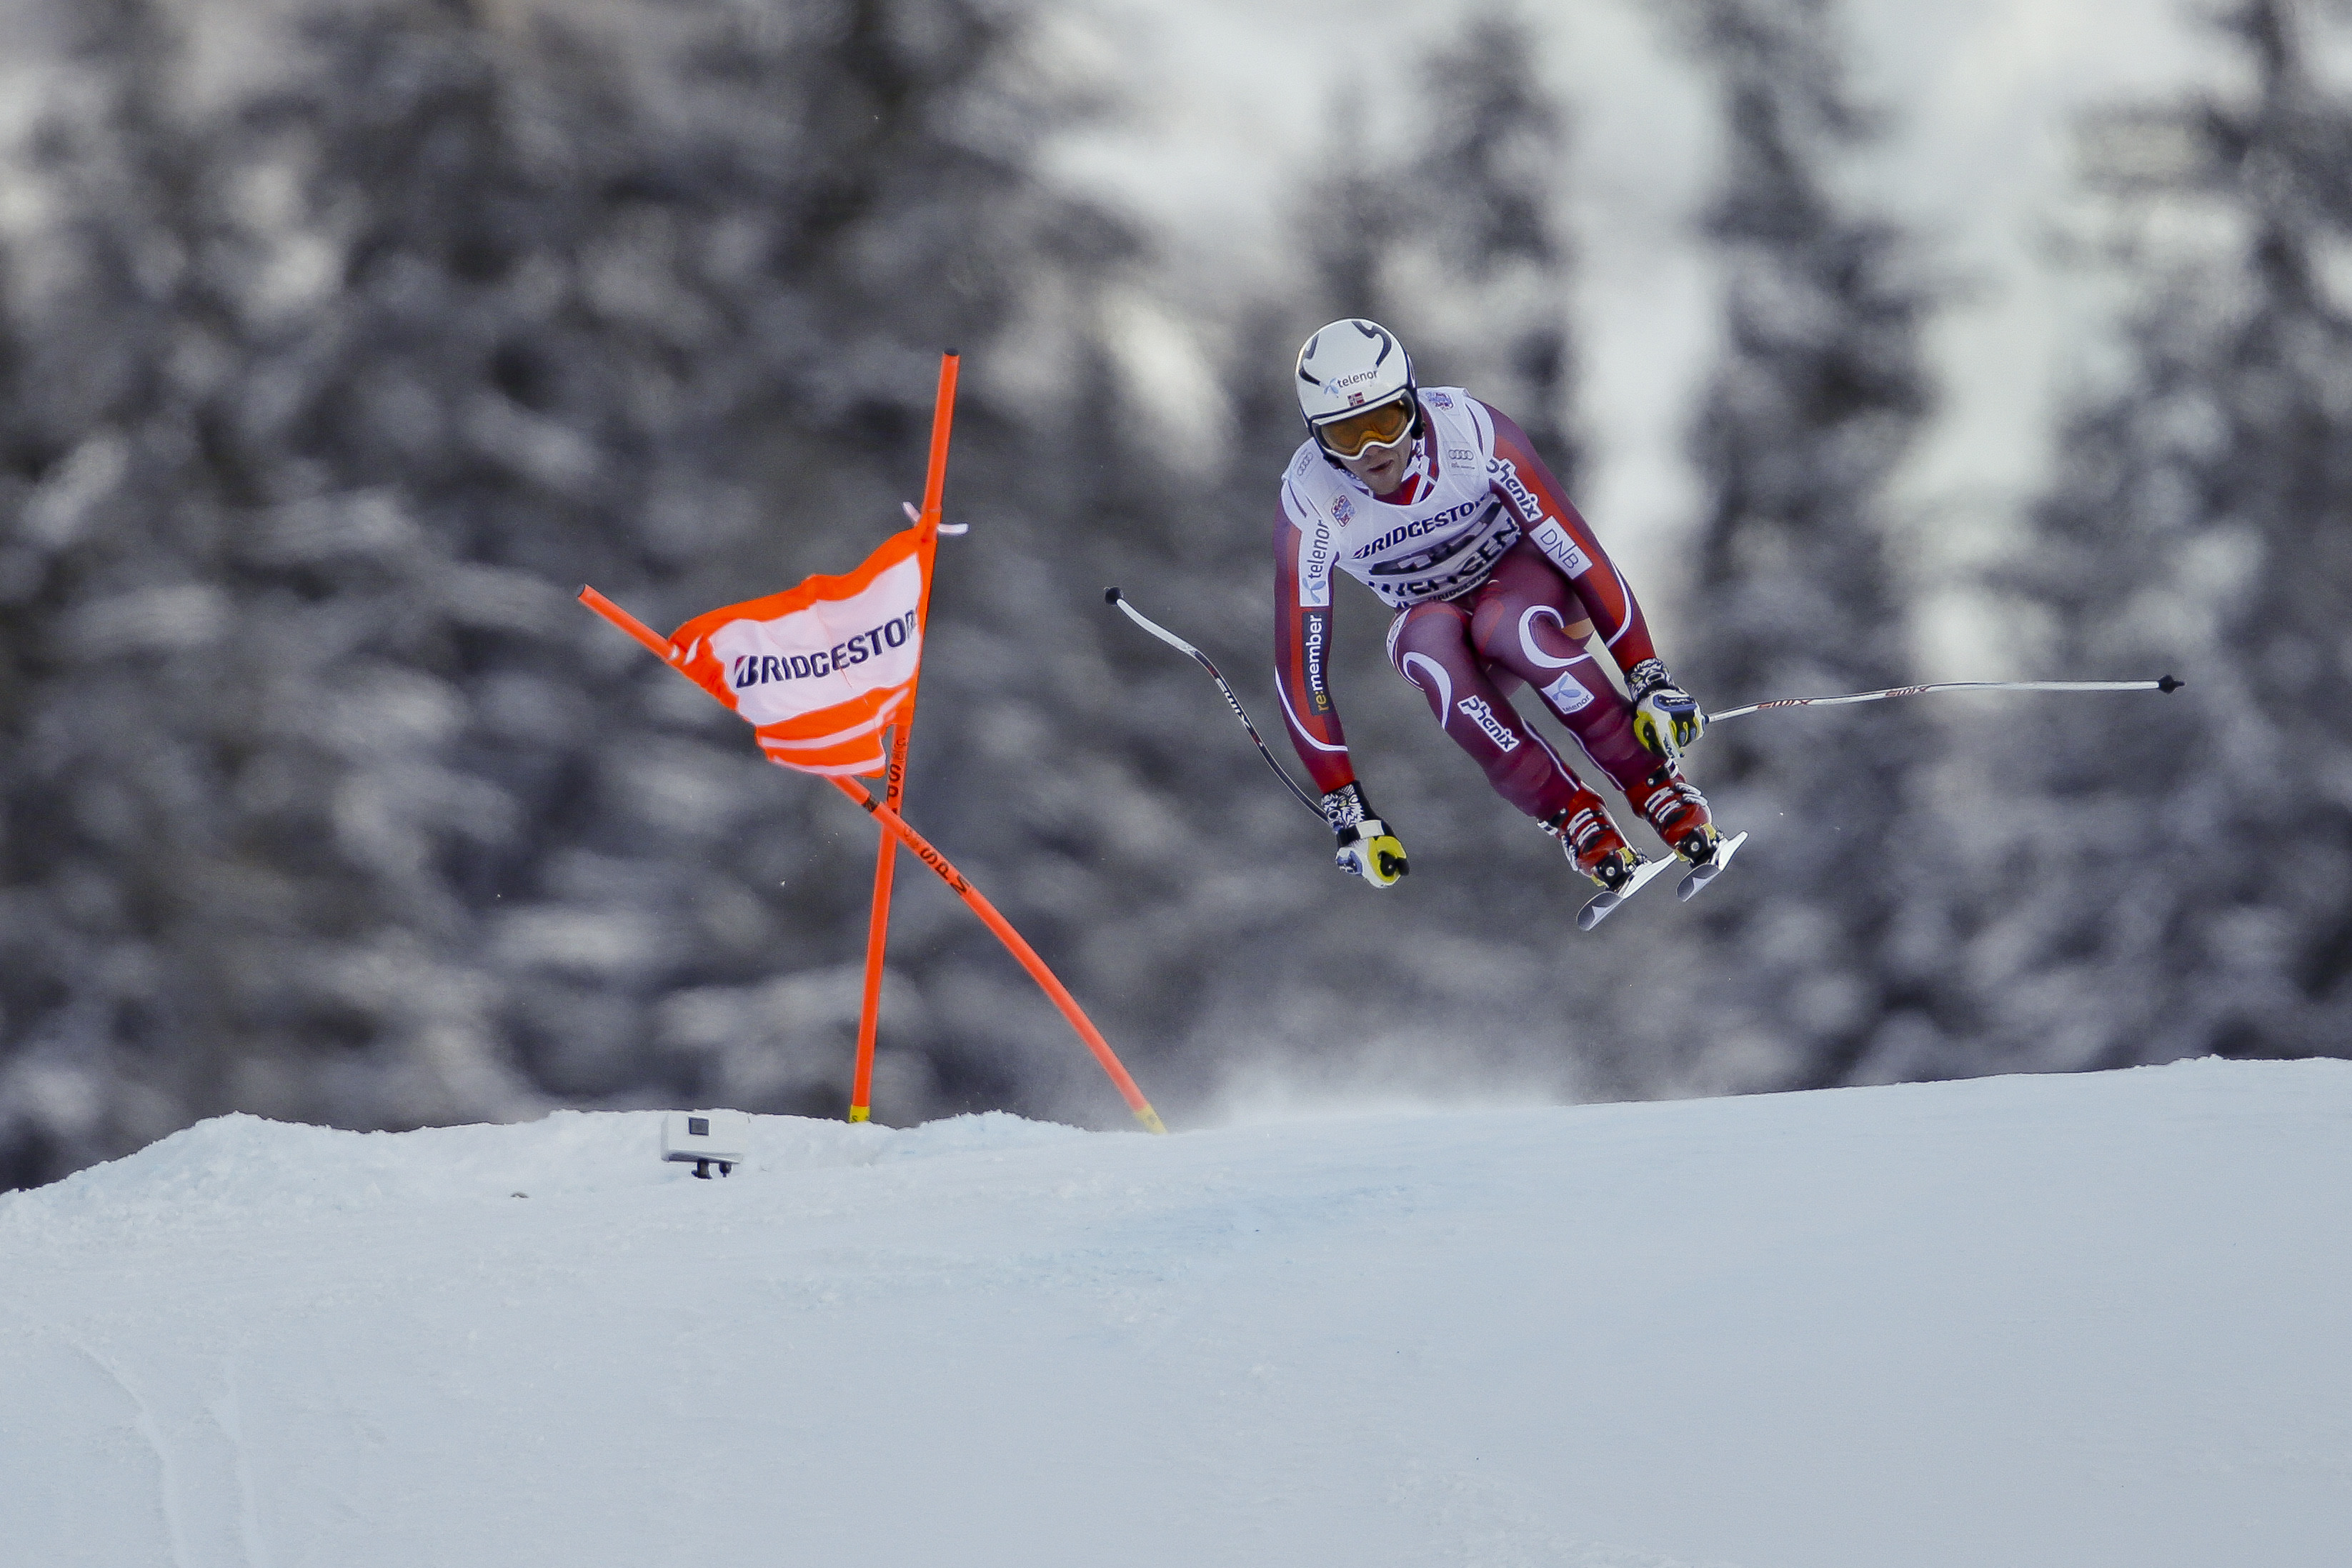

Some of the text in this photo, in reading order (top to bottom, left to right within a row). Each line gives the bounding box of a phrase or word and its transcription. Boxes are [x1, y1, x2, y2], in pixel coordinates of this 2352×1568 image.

[1337, 370, 1377, 388] telenor
[1307, 519, 1330, 579] telenor
[1540, 528, 1579, 569] DNB
[1305, 614, 1330, 711] re:member
[887, 764, 902, 814] SP
